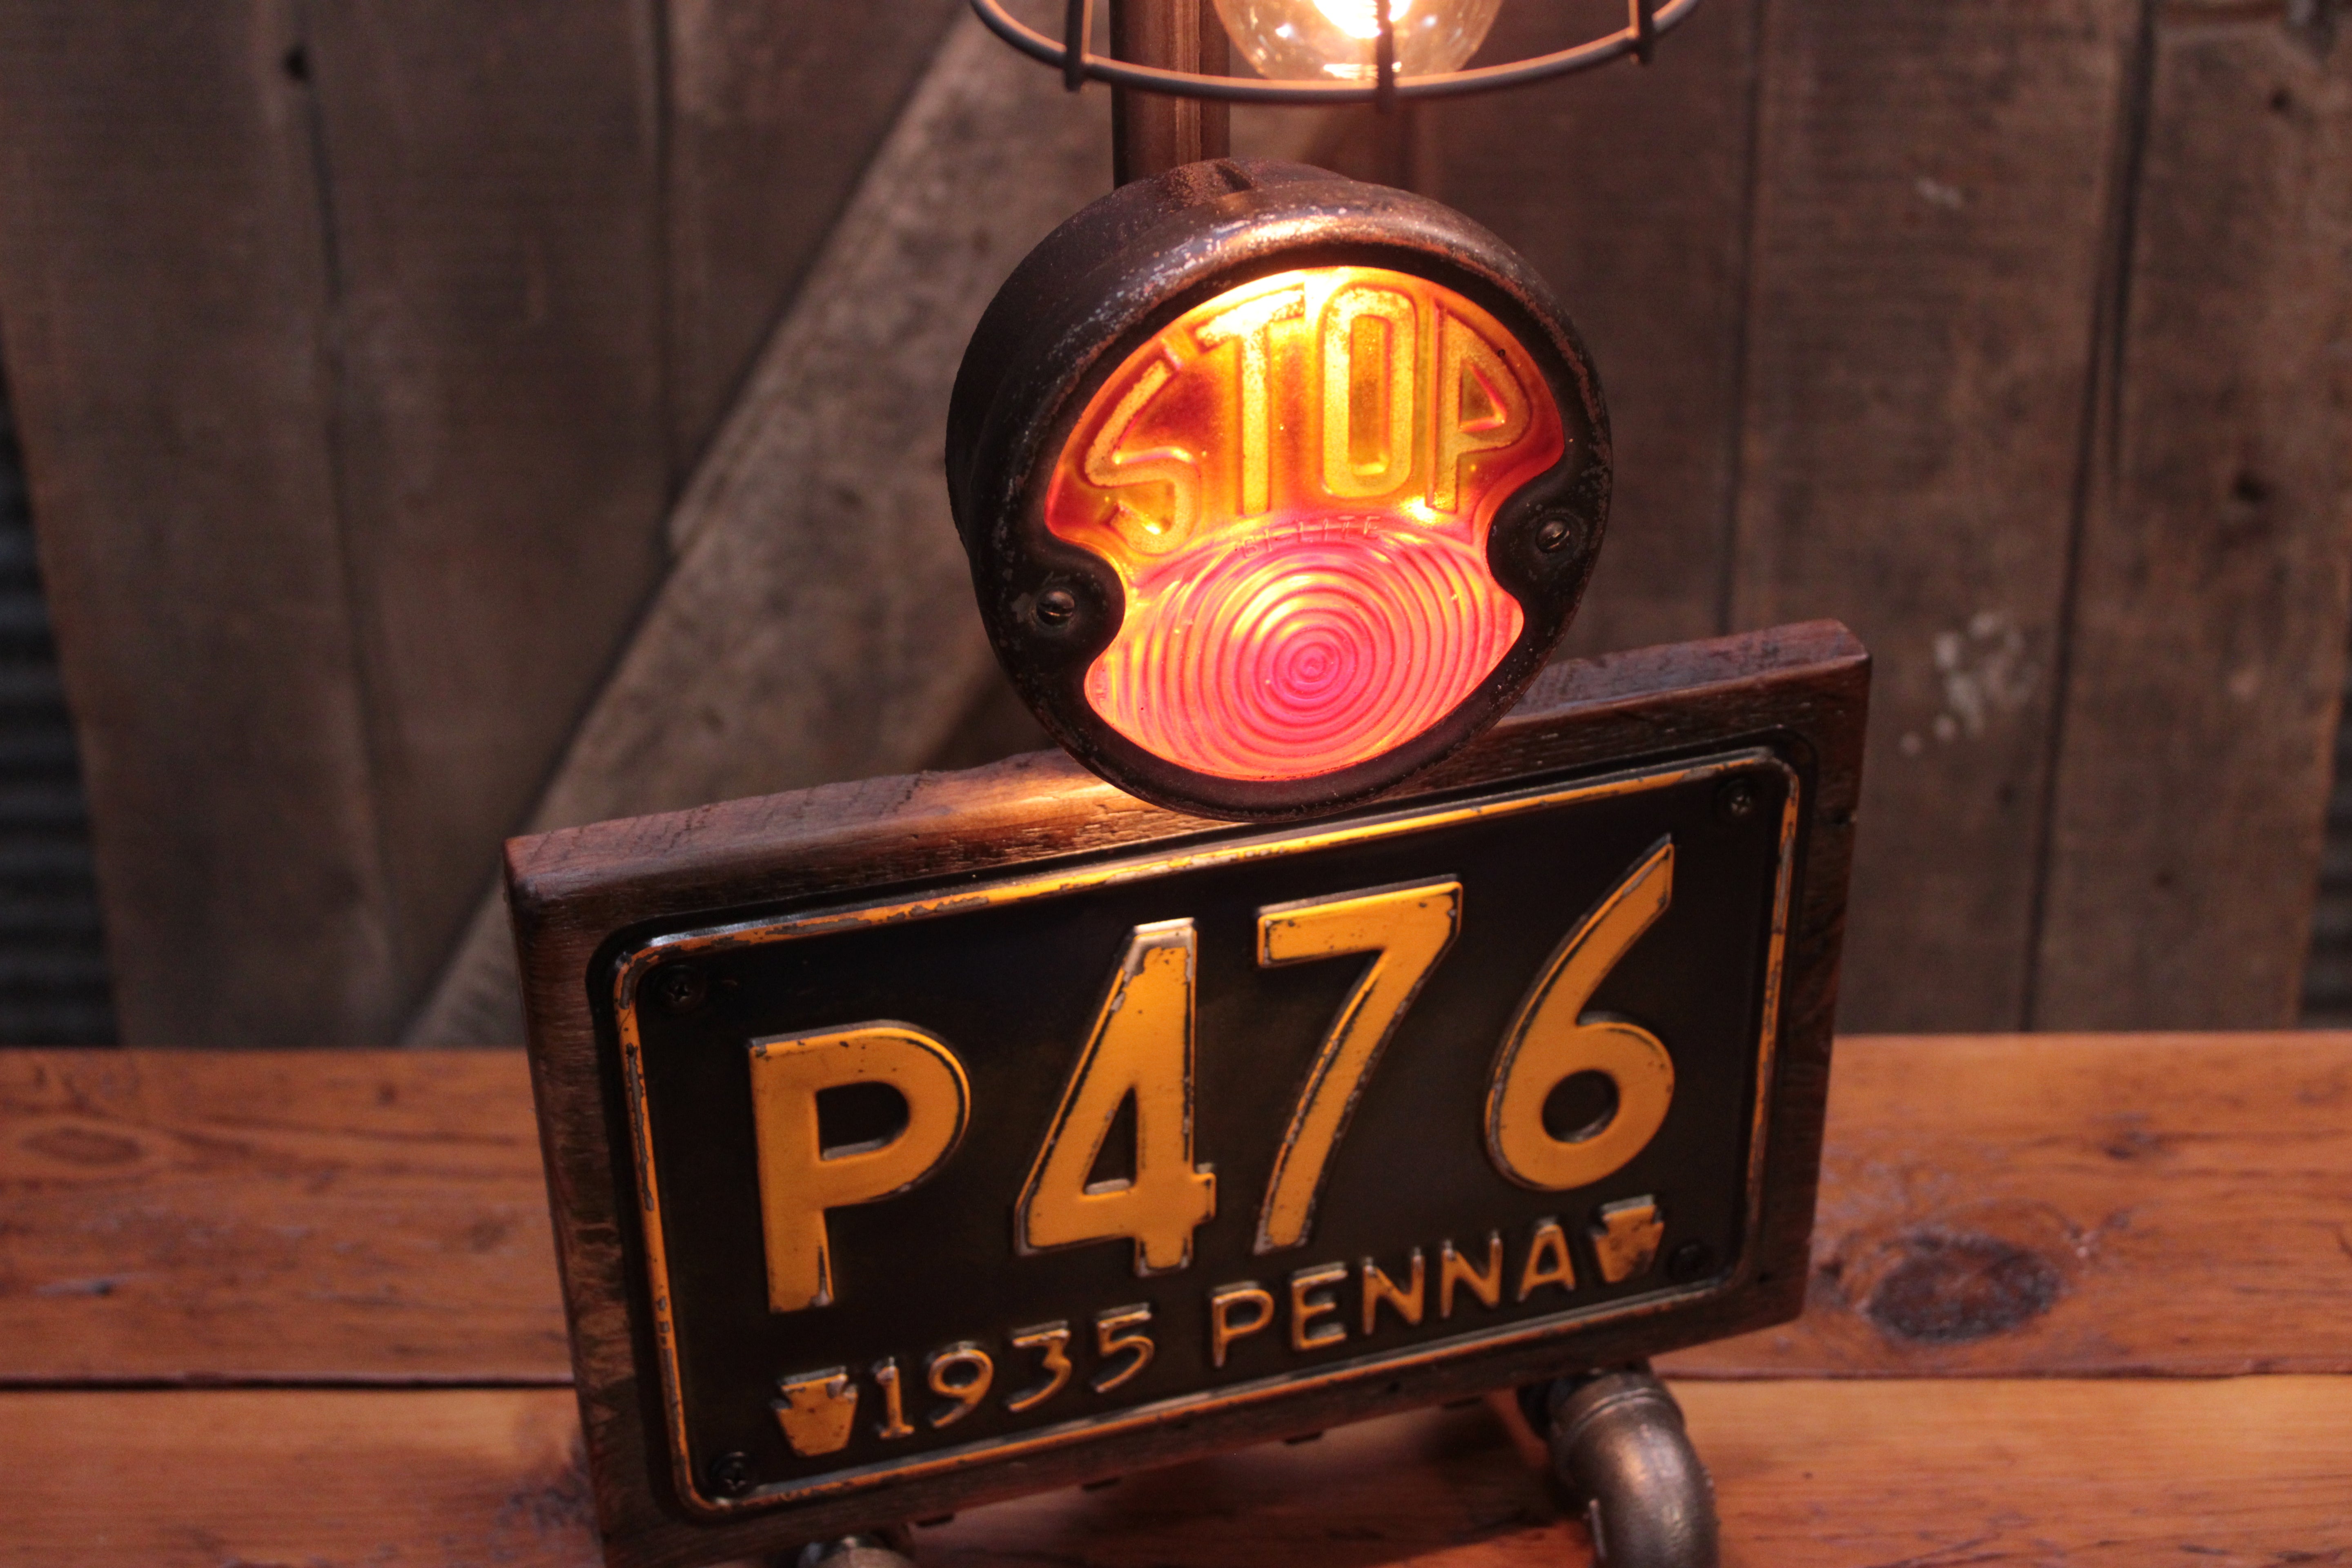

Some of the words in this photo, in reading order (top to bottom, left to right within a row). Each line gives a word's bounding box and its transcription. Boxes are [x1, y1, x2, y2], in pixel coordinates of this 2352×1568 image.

[1083, 282, 1532, 556] STOP
[749, 834, 1675, 1313] P476
[873, 1303, 1154, 1440] 1935
[1211, 1218, 1576, 1368] PENNA
